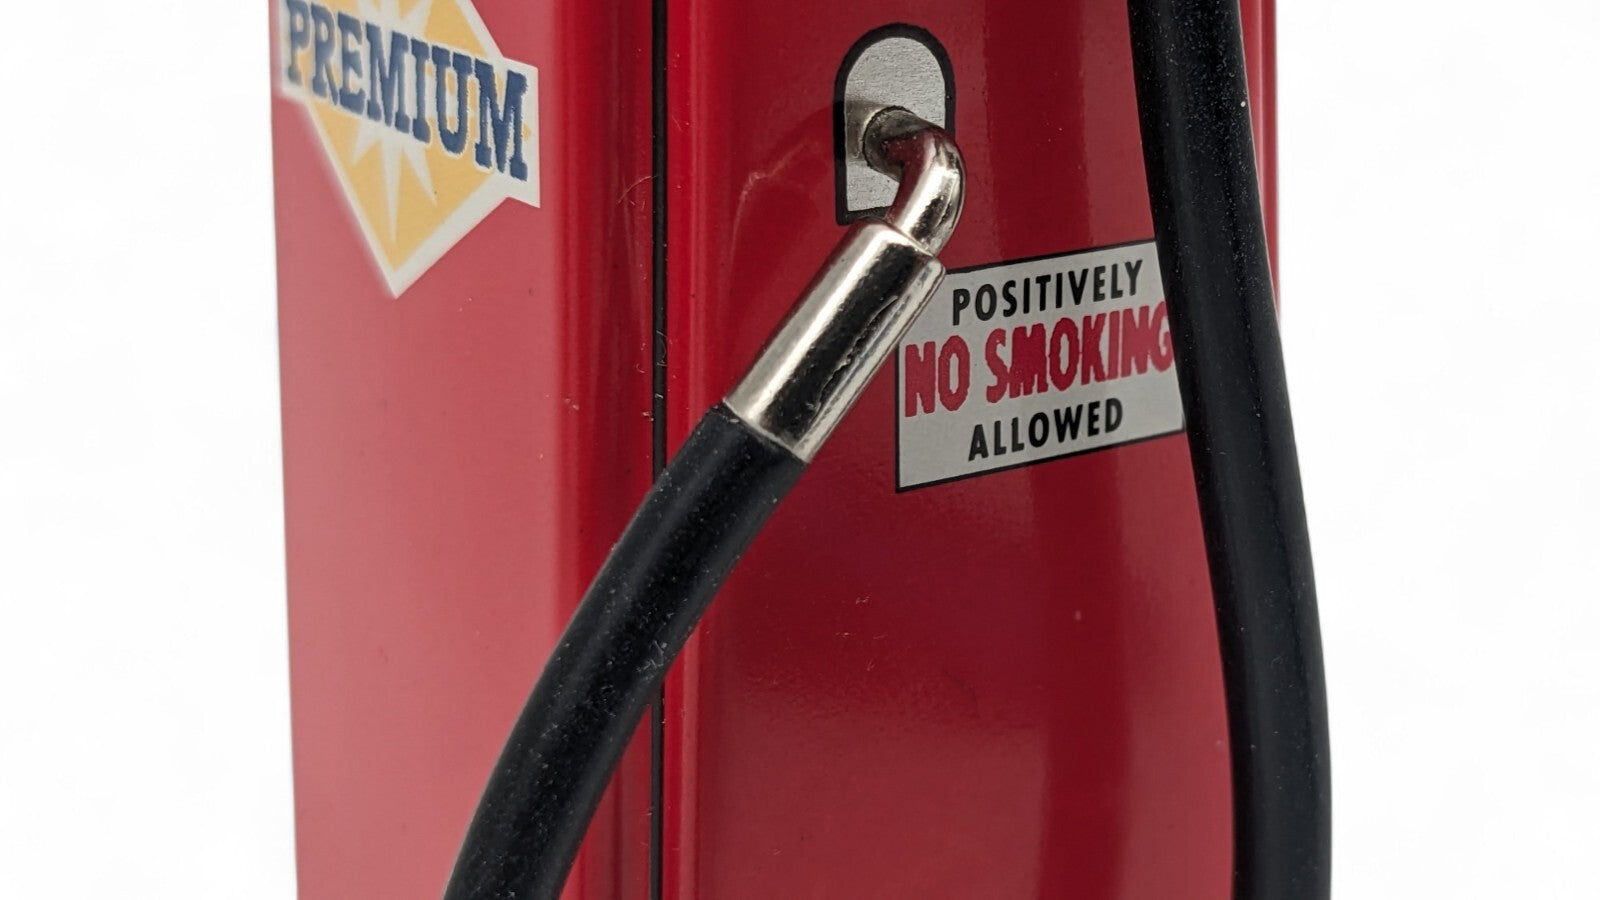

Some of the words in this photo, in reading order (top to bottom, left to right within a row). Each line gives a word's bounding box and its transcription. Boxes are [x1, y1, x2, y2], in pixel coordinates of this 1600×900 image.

[285, 0, 528, 182] PREMIUM
[952, 259, 1143, 326] POSITIVELY
[905, 335, 970, 418] NO
[985, 300, 1175, 404] SMOKING
[968, 398, 1124, 461] ALLOWED
